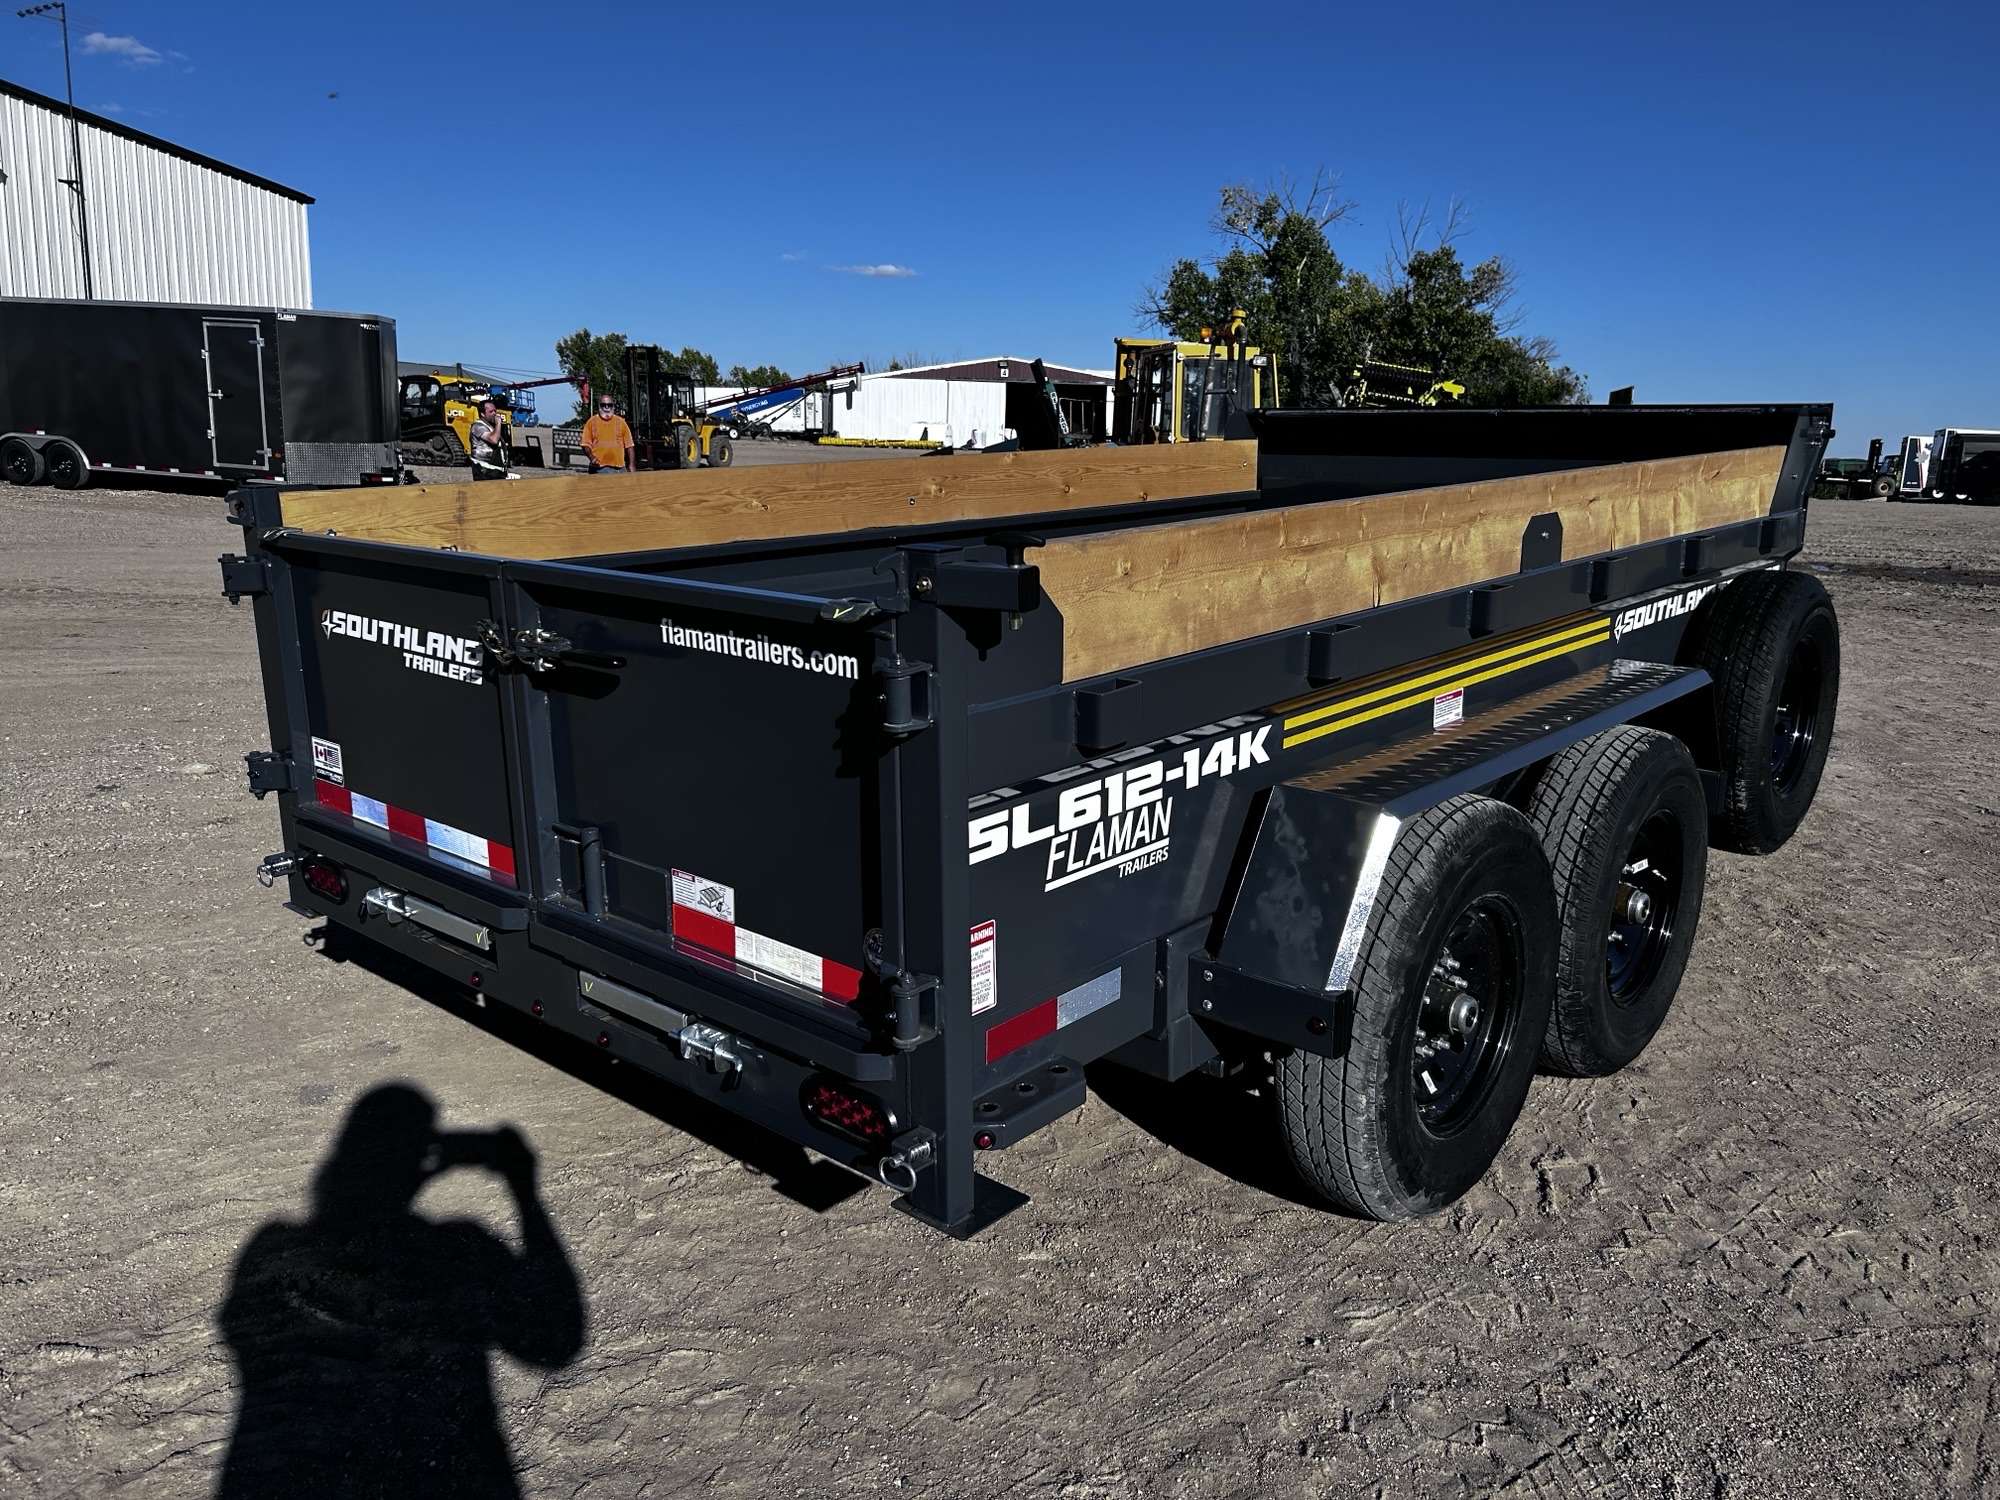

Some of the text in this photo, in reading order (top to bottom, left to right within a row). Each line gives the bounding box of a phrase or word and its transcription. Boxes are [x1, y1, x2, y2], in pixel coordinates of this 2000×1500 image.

[1622, 583, 1717, 634] SOUTHLAN
[403, 652, 483, 685] TRAILERS
[660, 617, 860, 680] flamantrailers.com
[968, 725, 1272, 866] SL612-14K
[1046, 796, 1174, 881] FLAMAN
[1118, 846, 1170, 879] TRAILERS
[970, 926, 994, 944] ARNING
